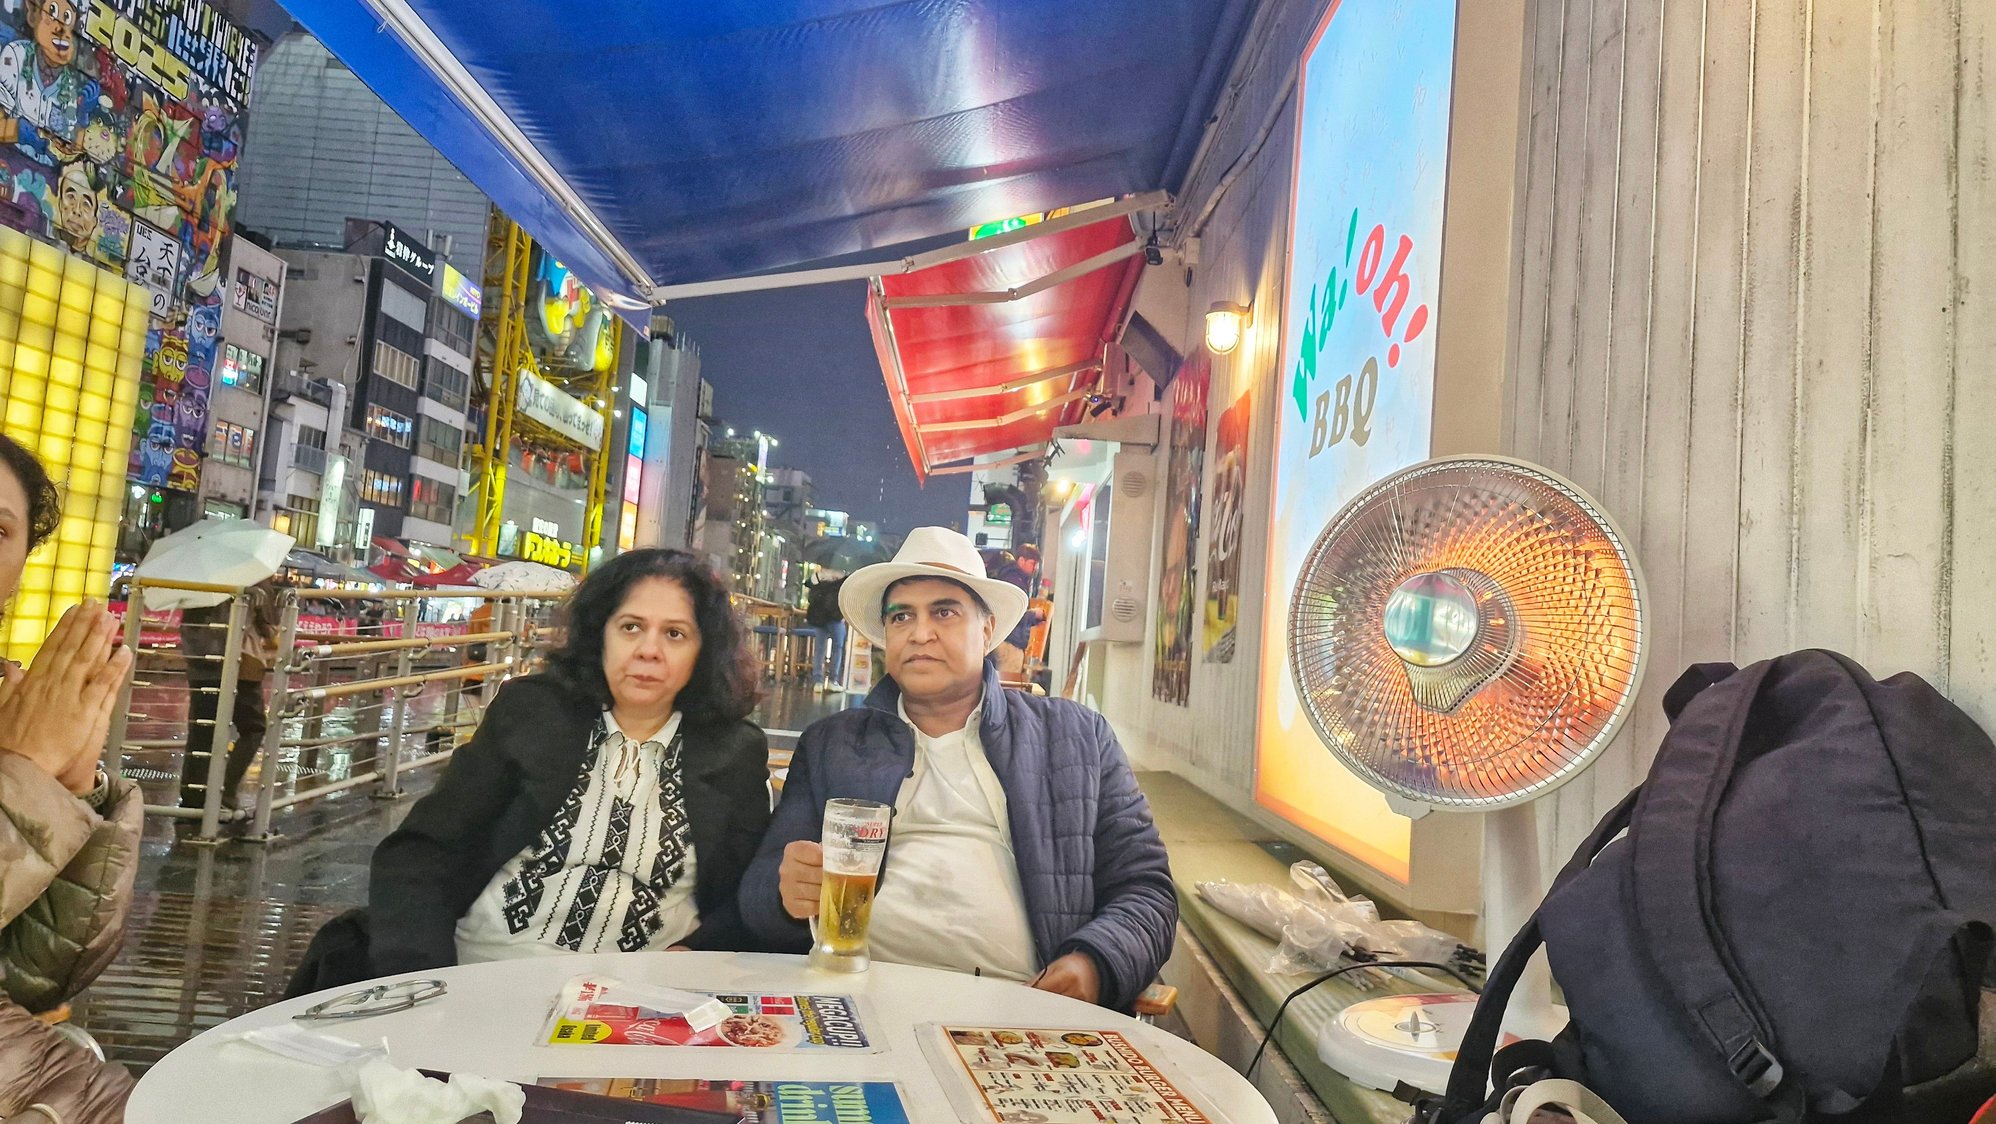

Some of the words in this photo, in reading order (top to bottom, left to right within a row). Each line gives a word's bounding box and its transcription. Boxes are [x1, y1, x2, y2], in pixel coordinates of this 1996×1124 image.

[85, 0, 191, 101] 2025
[1308, 356, 1378, 460] BBQ
[813, 996, 864, 1047] MEGACUP!!
[1103, 1034, 1144, 1065] BUSHIDO
[1133, 1065, 1178, 1099] BURGER
[1166, 1098, 1206, 1124] MENU
